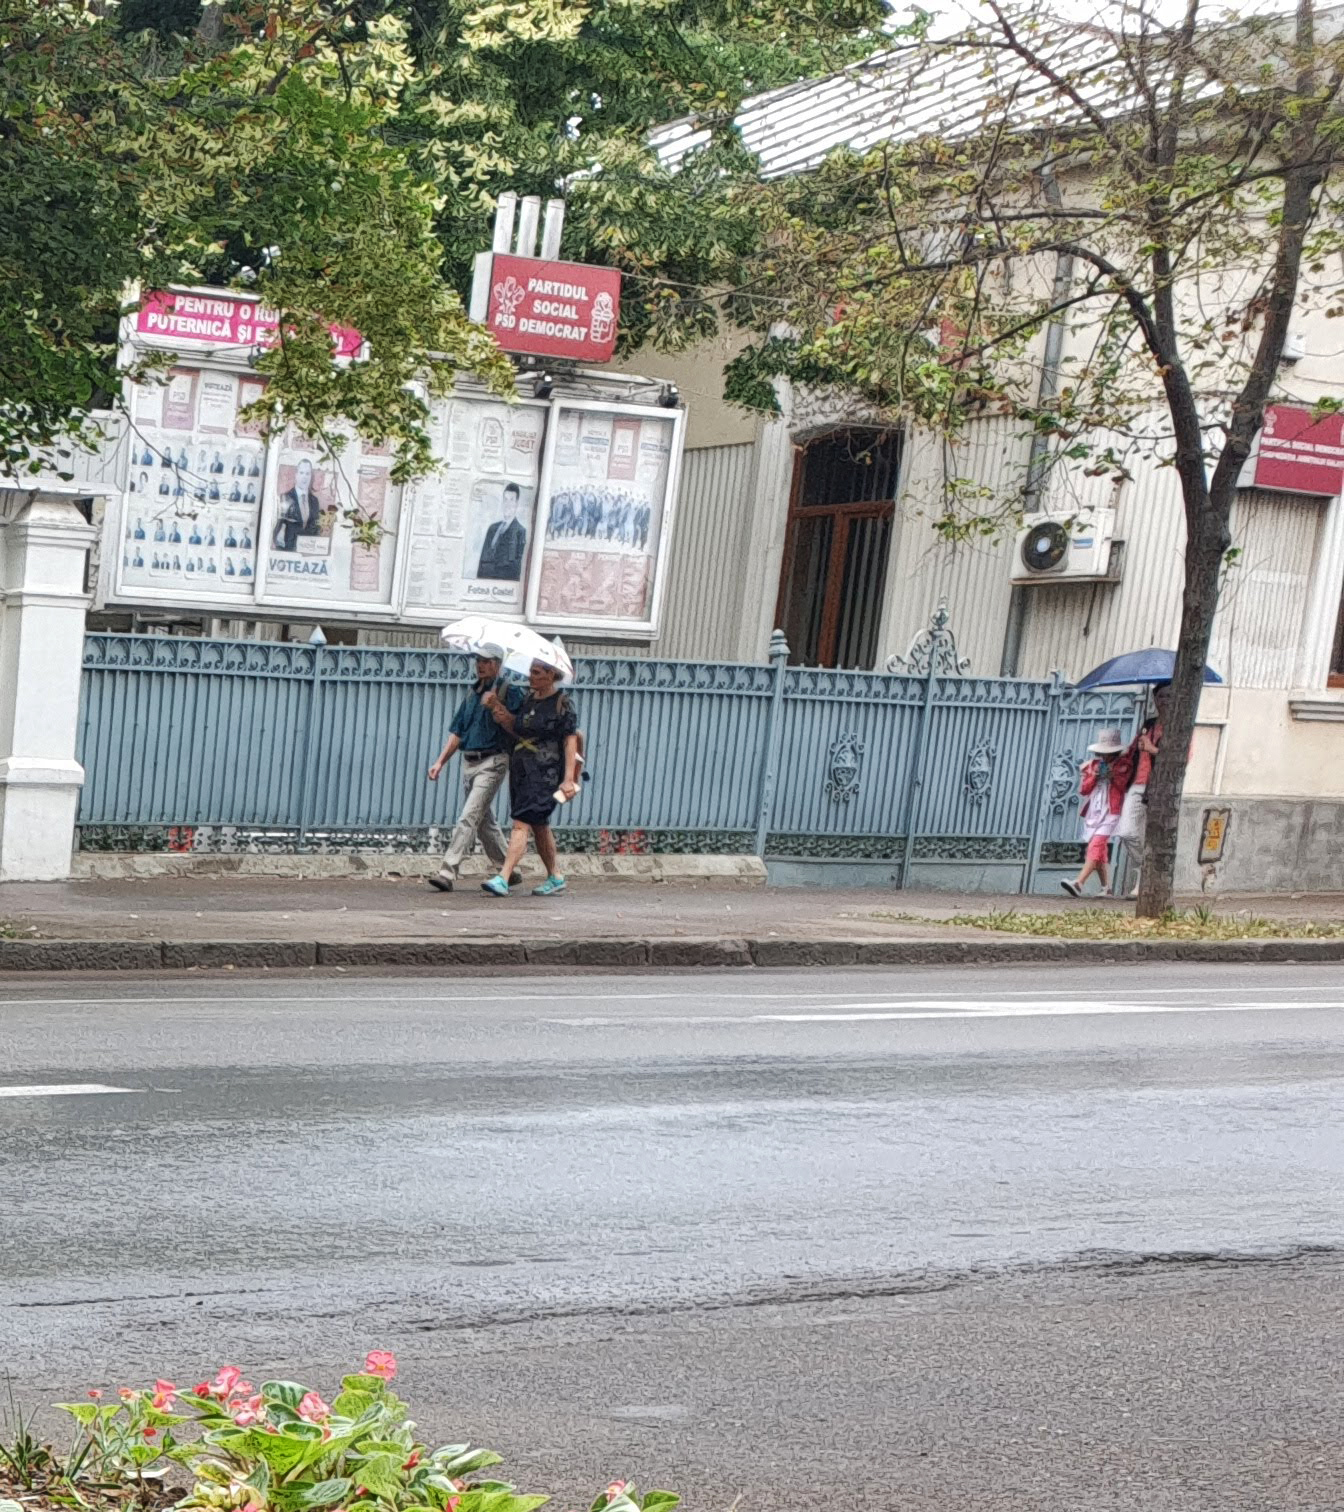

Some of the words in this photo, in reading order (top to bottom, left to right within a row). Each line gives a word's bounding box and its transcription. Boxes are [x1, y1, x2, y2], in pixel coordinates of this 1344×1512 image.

[527, 278, 589, 300] PARTIDUL
[175, 295, 234, 317] PENTRU
[239, 304, 252, 320] O
[532, 299, 579, 319] SOCIAL
[147, 312, 232, 338] PUTERNICĂ
[495, 313, 516, 329] PSD
[519, 318, 588, 341] DEMOCRAT
[269, 558, 329, 576] VOTEAZĂ
